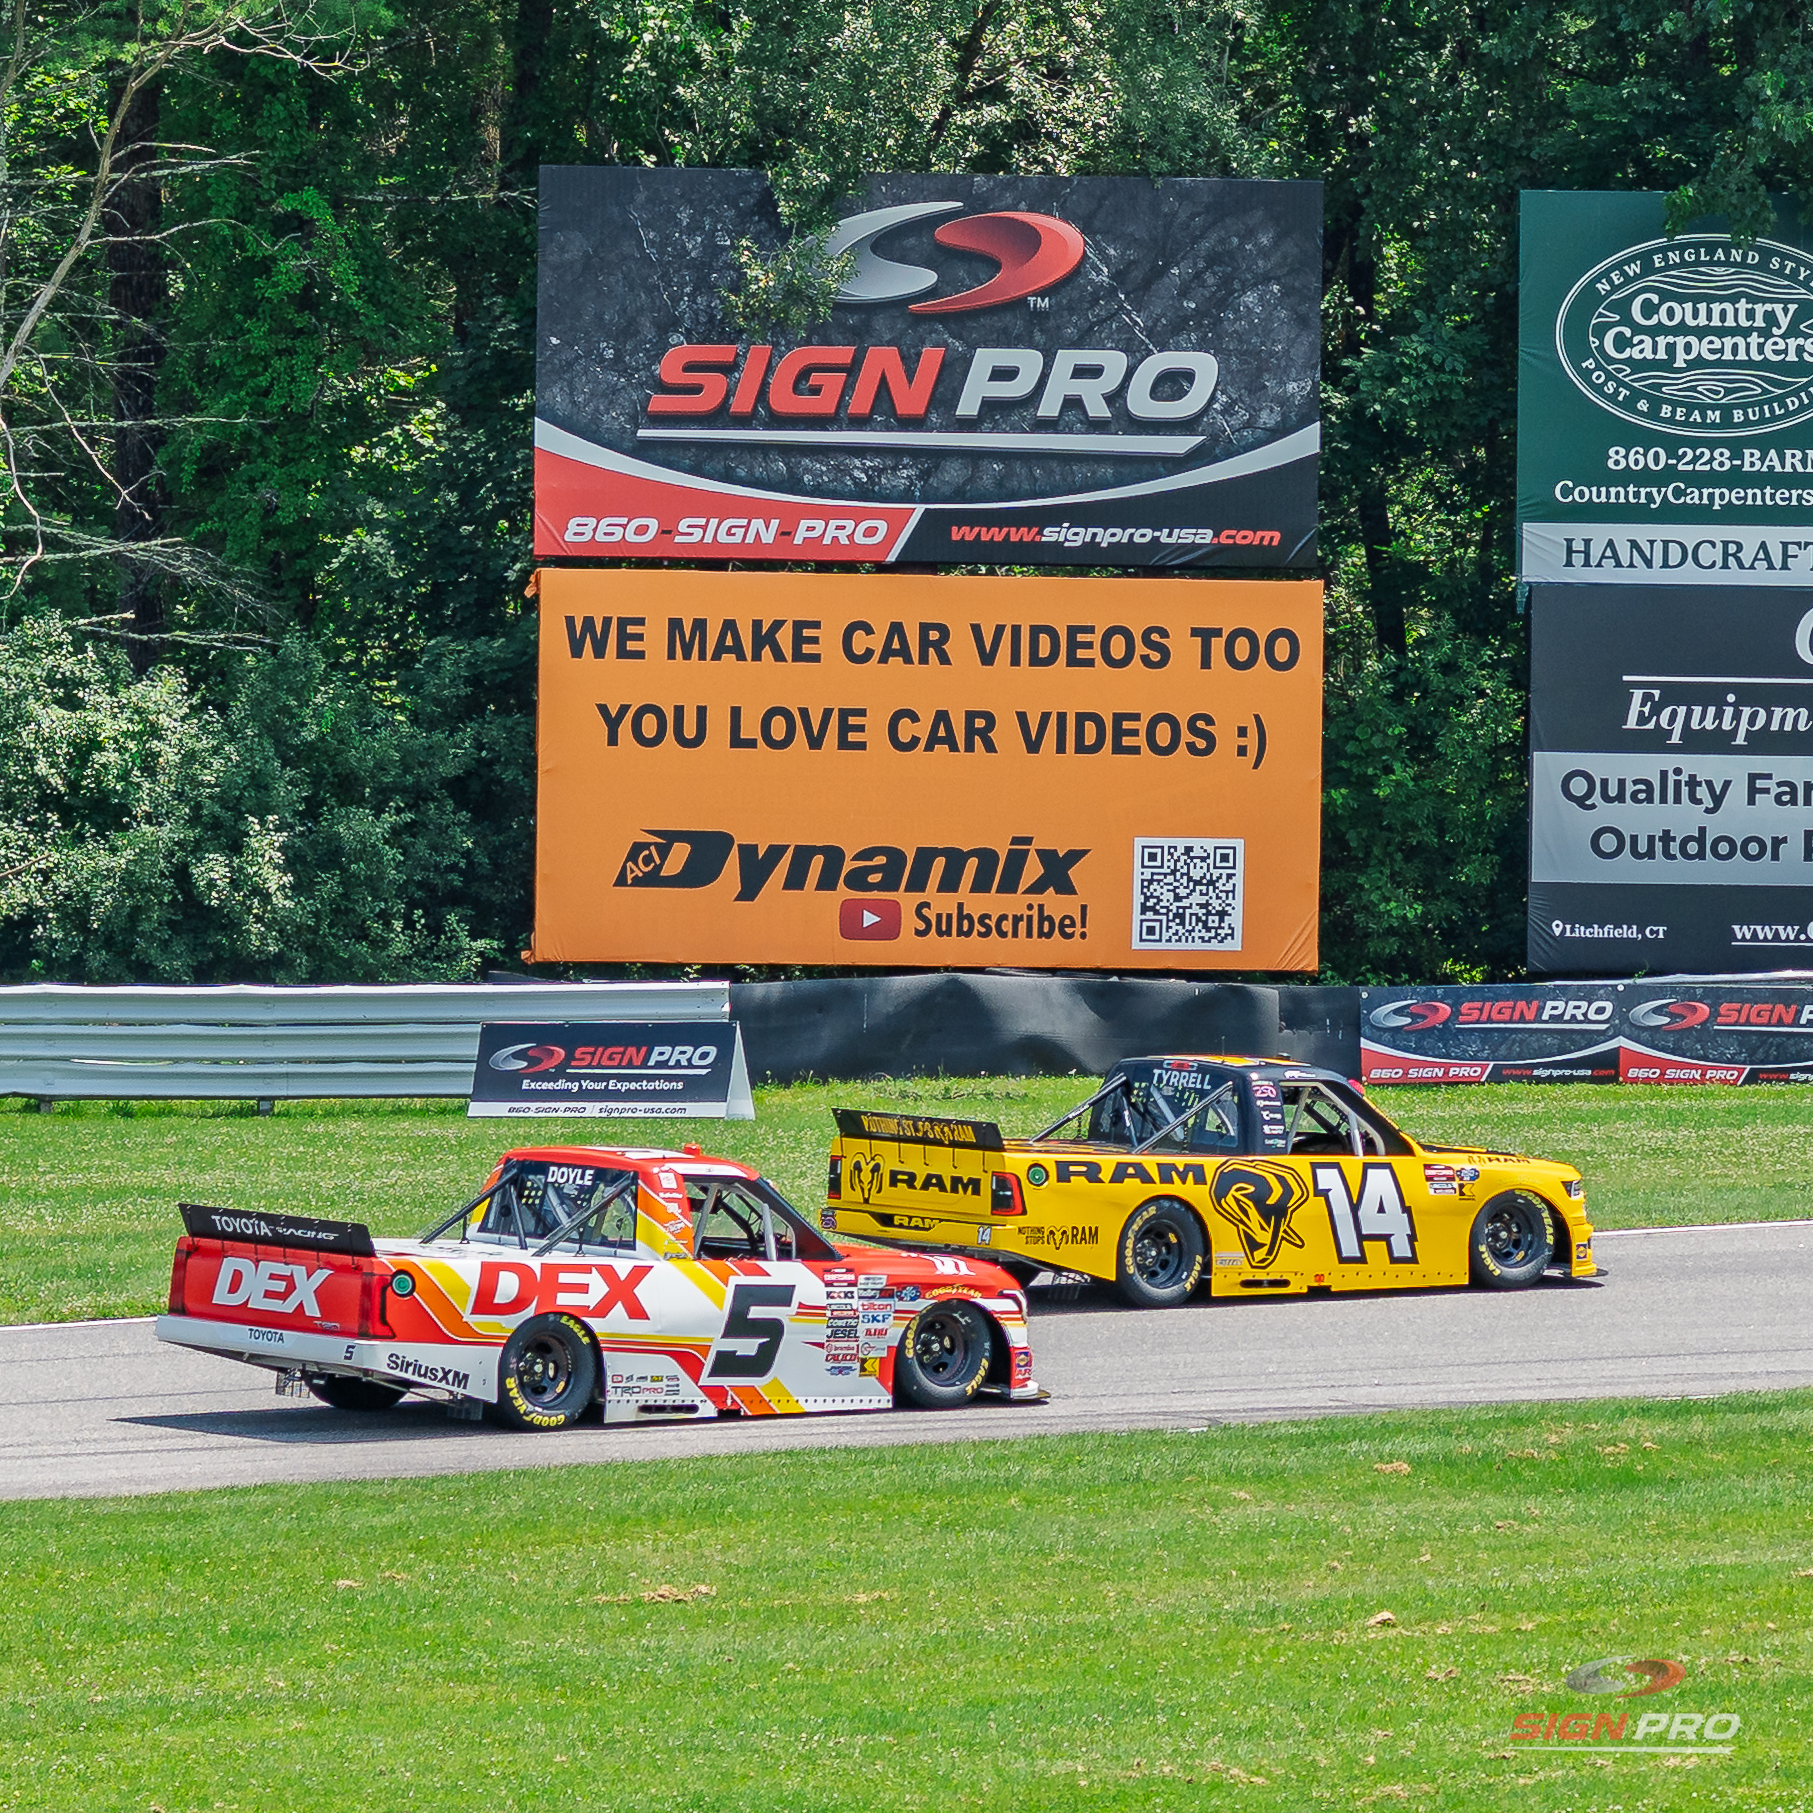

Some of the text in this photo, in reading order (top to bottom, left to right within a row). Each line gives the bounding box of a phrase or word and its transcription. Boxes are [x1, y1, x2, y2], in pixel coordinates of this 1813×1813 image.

[1595, 248, 1813, 295] NEW ENGLAND STY
[1027, 297, 1050, 311] TM
[1631, 293, 1799, 335] Country
[1603, 326, 1813, 367] Carpenters
[646, 343, 1221, 421] SIGN PRO
[1581, 358, 1813, 423] POST & BEAM BUILDI
[563, 515, 1282, 548] 860-SIGN-PRO www.signpro-usa.com
[564, 614, 1301, 673] WE MAKE CAR VIDEOS TOO
[595, 702, 1268, 770] YOU LOVE CAR VIDEOS :)
[1560, 766, 1733, 815] Quality
[1589, 825, 1788, 863] Outdoor
[612, 828, 1092, 903] Dynamix
[625, 845, 661, 885] ACI
[913, 901, 1089, 941] Subscribe!
[1564, 924, 1667, 941] Litchfield, CT
[1457, 1000, 1614, 1022] SIGN PRO
[1716, 1002, 1798, 1025] SIGN
[570, 1046, 718, 1067] SIGN PRO
[522, 1079, 683, 1093] Exceeding Your Expectations
[1152, 1069, 1212, 1090] TYRRELL
[598, 1105, 687, 1116] signpro-usa.com
[547, 1166, 595, 1186] DOYLE
[888, 1169, 982, 1196] RAM
[1054, 1160, 1208, 1185] RAM
[211, 1215, 273, 1237] TOYOTA
[893, 1215, 941, 1229] RAM
[1310, 1162, 1420, 1265] 14
[976, 1226, 992, 1246] 14
[1071, 1226, 1099, 1245] RAM
[1184, 1254, 1203, 1293] EAGLE
[1478, 1243, 1502, 1277] EAGLE
[212, 1257, 335, 1318] DEX
[469, 1261, 654, 1320] DEX
[925, 1283, 983, 1299] GOODYEAR
[559, 1315, 591, 1346] EAGLE
[707, 1284, 797, 1378] 5
[826, 1328, 860, 1339] JESEL
[860, 1314, 892, 1323] SKF
[248, 1328, 285, 1343] TOYOTA
[343, 1344, 356, 1361] 5
[386, 1353, 470, 1390] SiriusXM
[965, 1358, 990, 1396] EAGLE
[505, 1376, 566, 1427] GOODYEAR
